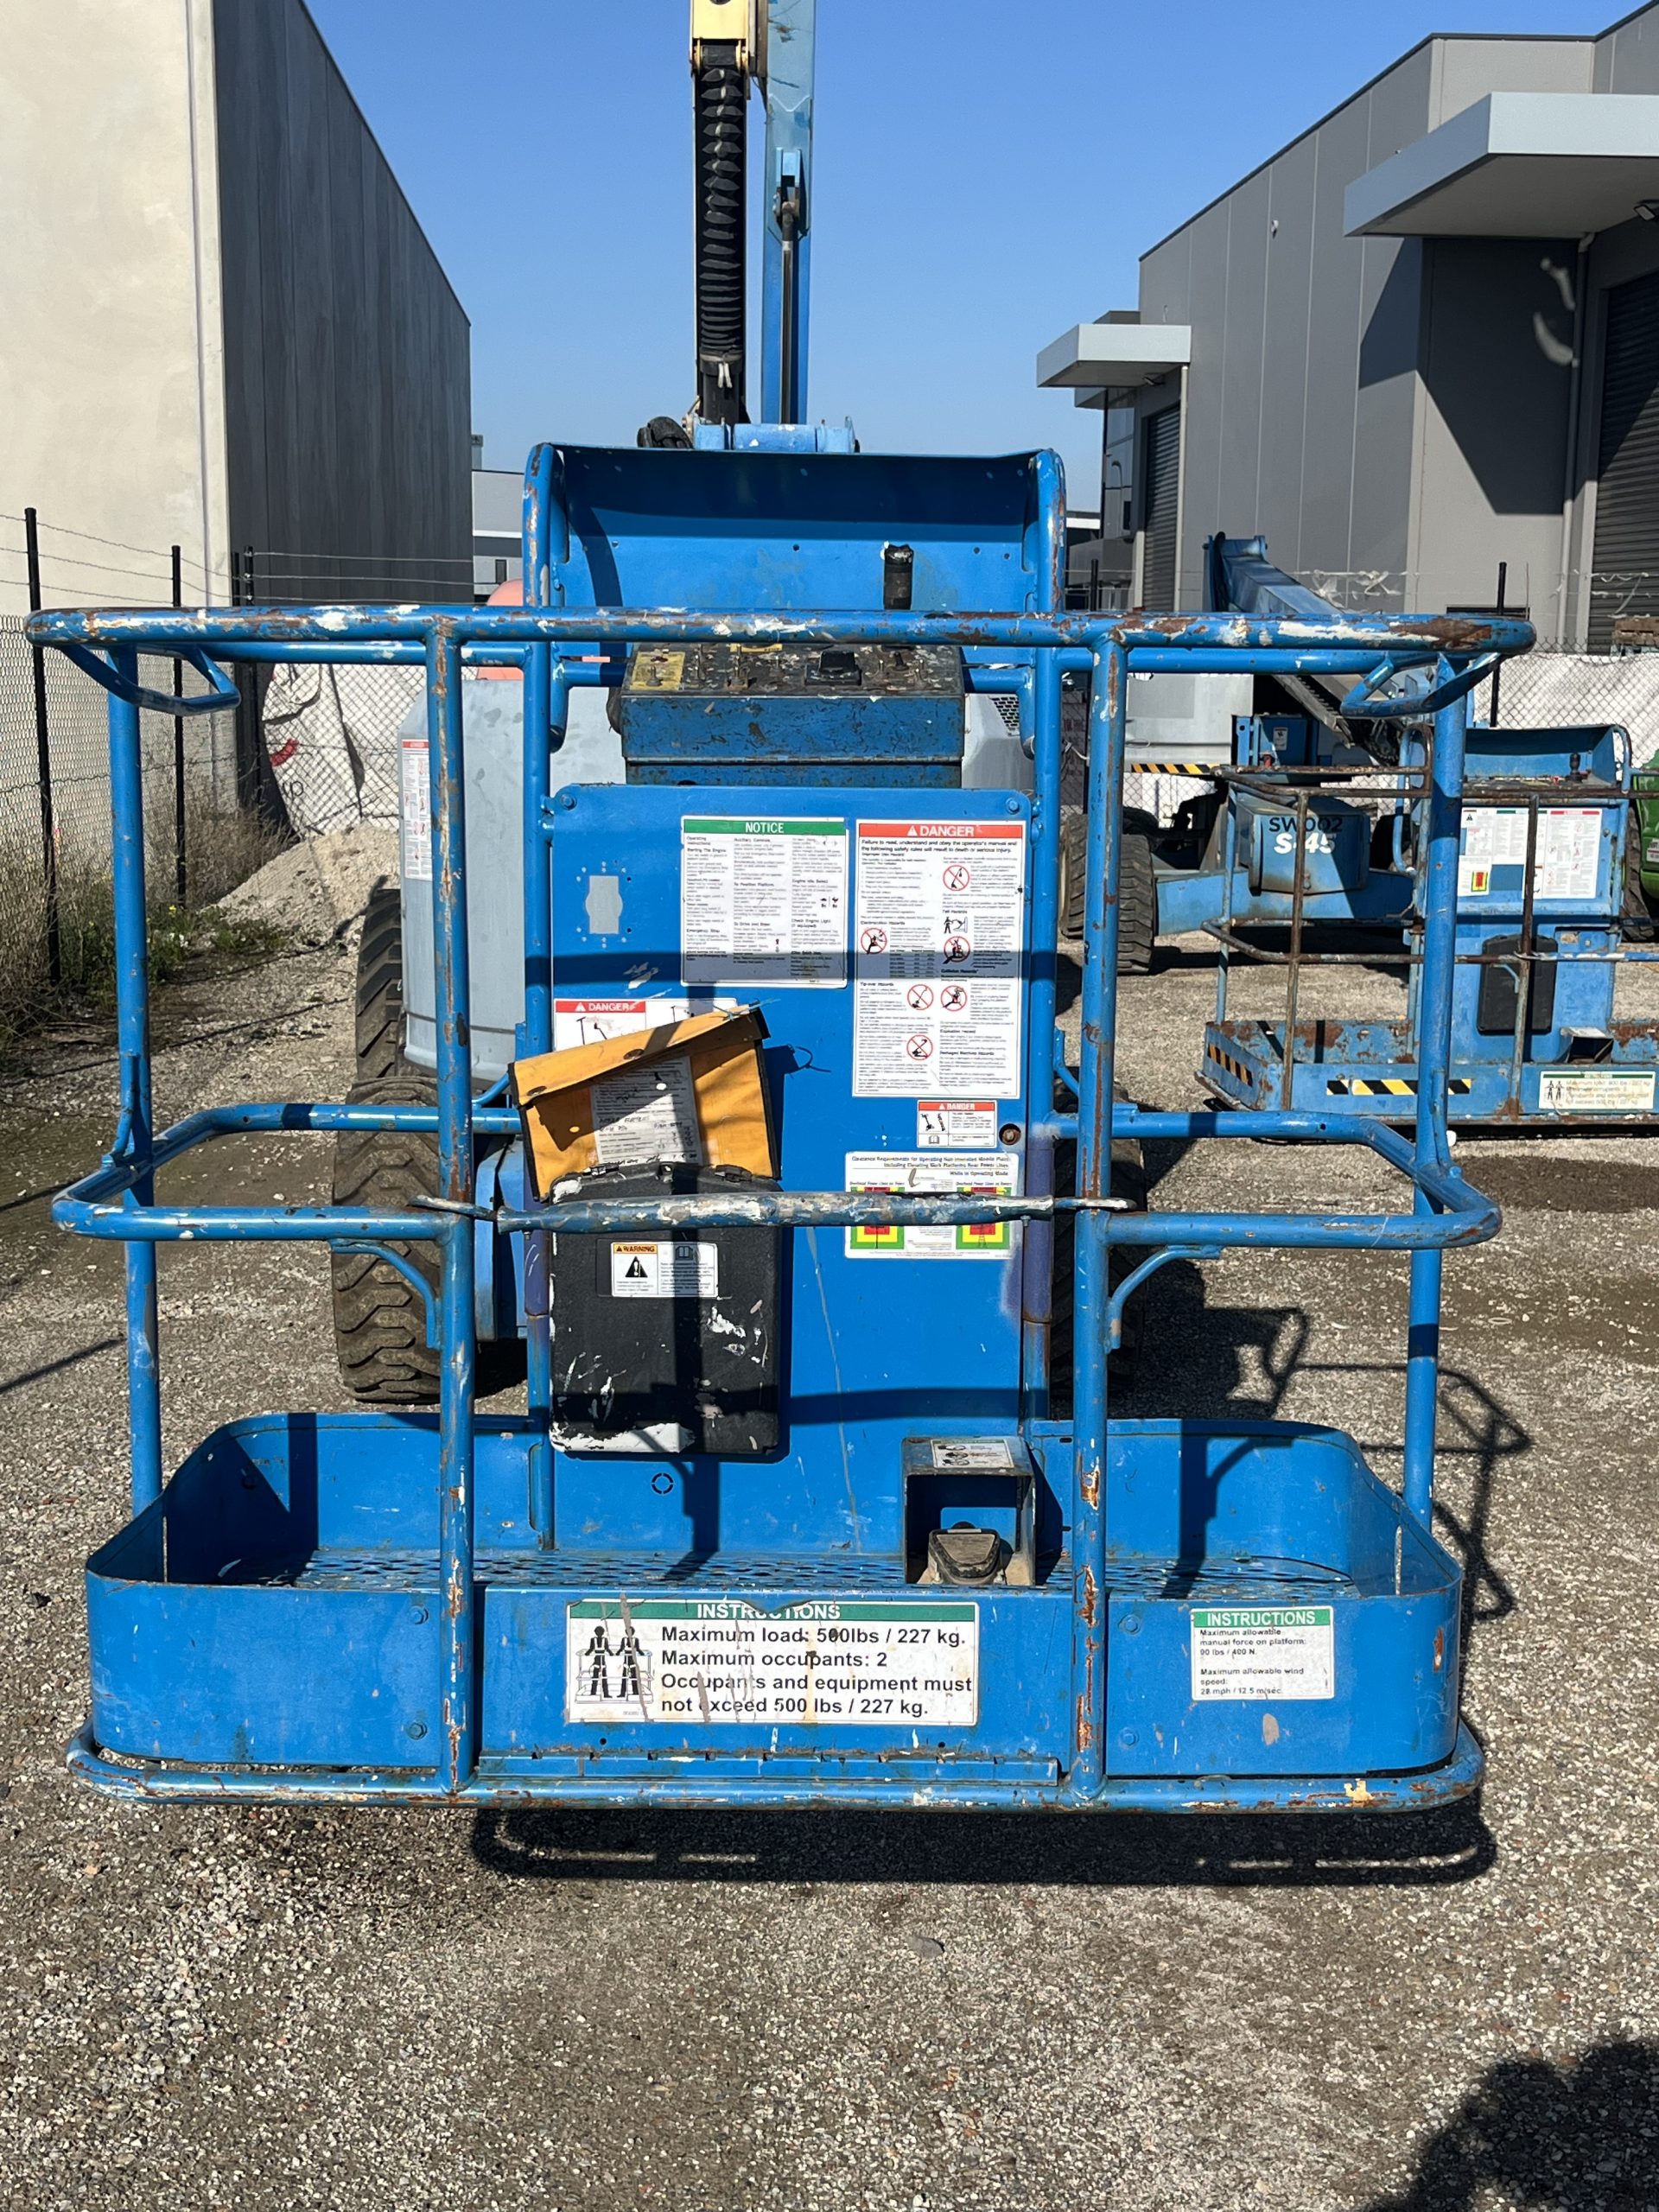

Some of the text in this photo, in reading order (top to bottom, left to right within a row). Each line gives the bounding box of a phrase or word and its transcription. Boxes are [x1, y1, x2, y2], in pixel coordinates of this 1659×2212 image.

[746, 823, 784, 833] NOTICE
[920, 826, 974, 836] DANGER
[1269, 817, 1343, 832] SW002
[1208, 1611, 1315, 1626] INSTRUCTIONS
[662, 1626, 965, 1647] Maximum load: 500lbs / 227 kg.
[662, 1650, 887, 1669] Maximum occupants: 2
[773, 1675, 808, 1689] and
[815, 1675, 918, 1693] equipment
[925, 1677, 972, 1691] must
[662, 1697, 928, 1718] not xceed 500 lbs / 227 kg.
